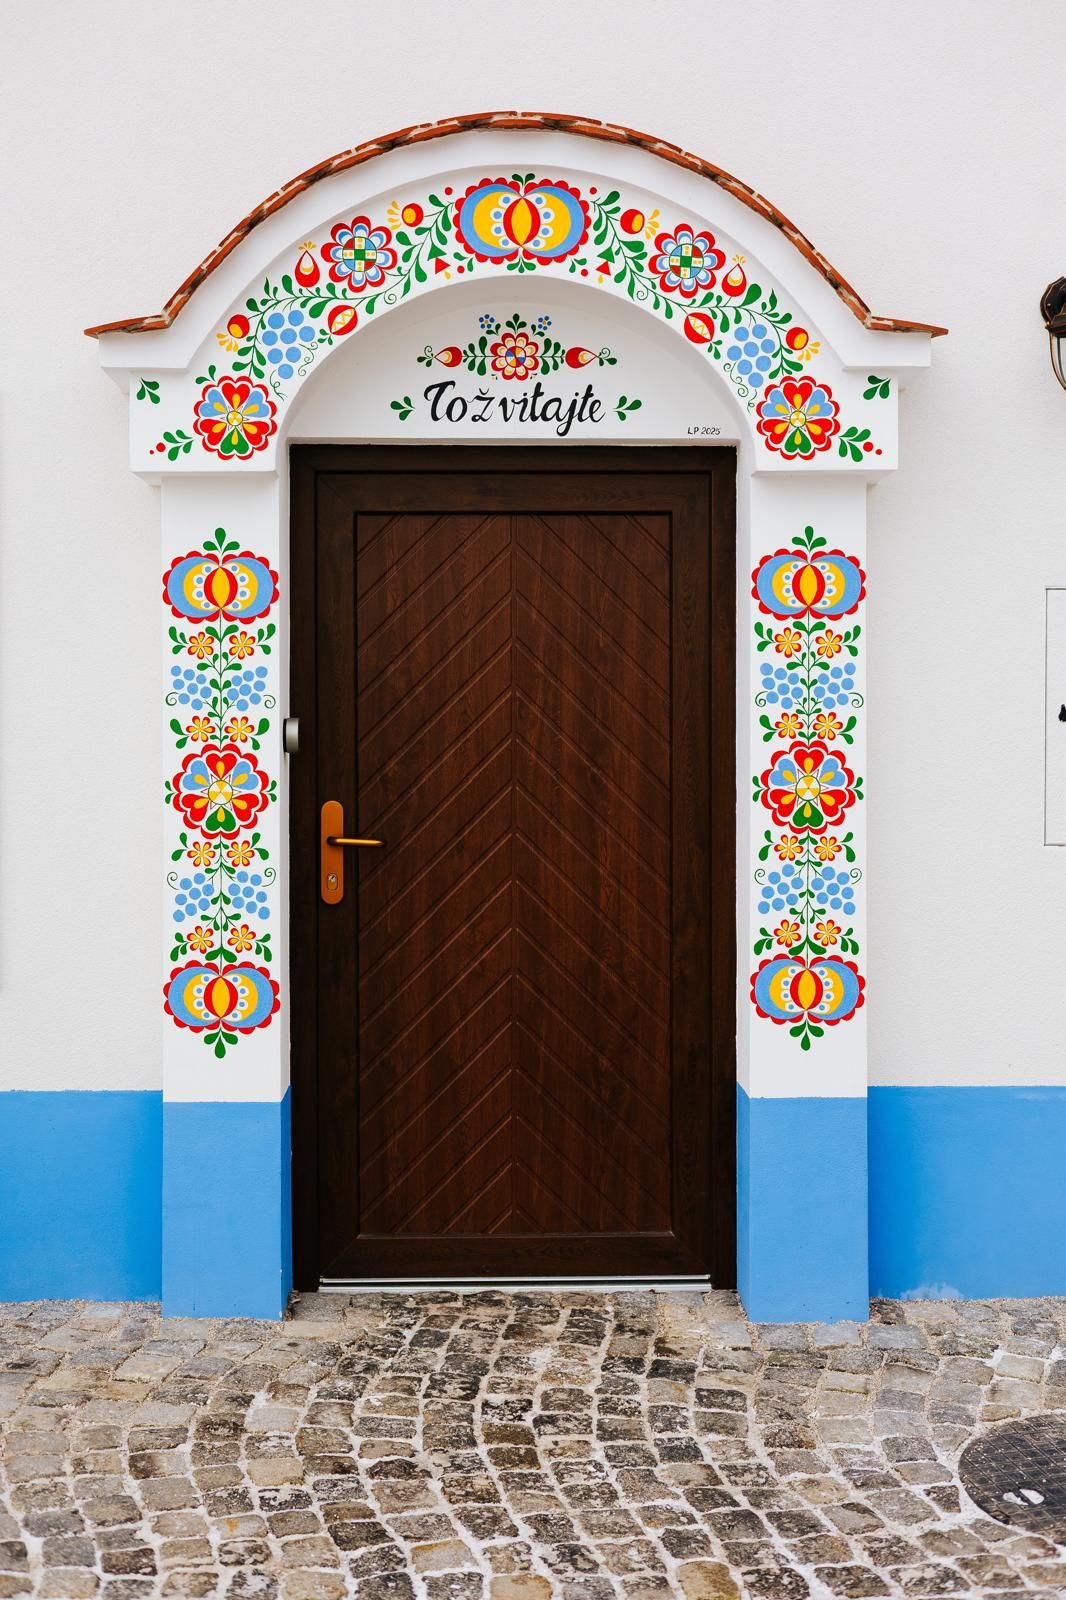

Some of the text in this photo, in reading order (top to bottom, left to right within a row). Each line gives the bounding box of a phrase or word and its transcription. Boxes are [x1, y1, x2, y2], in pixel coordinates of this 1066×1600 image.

[424, 380, 606, 437] Tož vitajte
[687, 426, 721, 436] LP 2025
